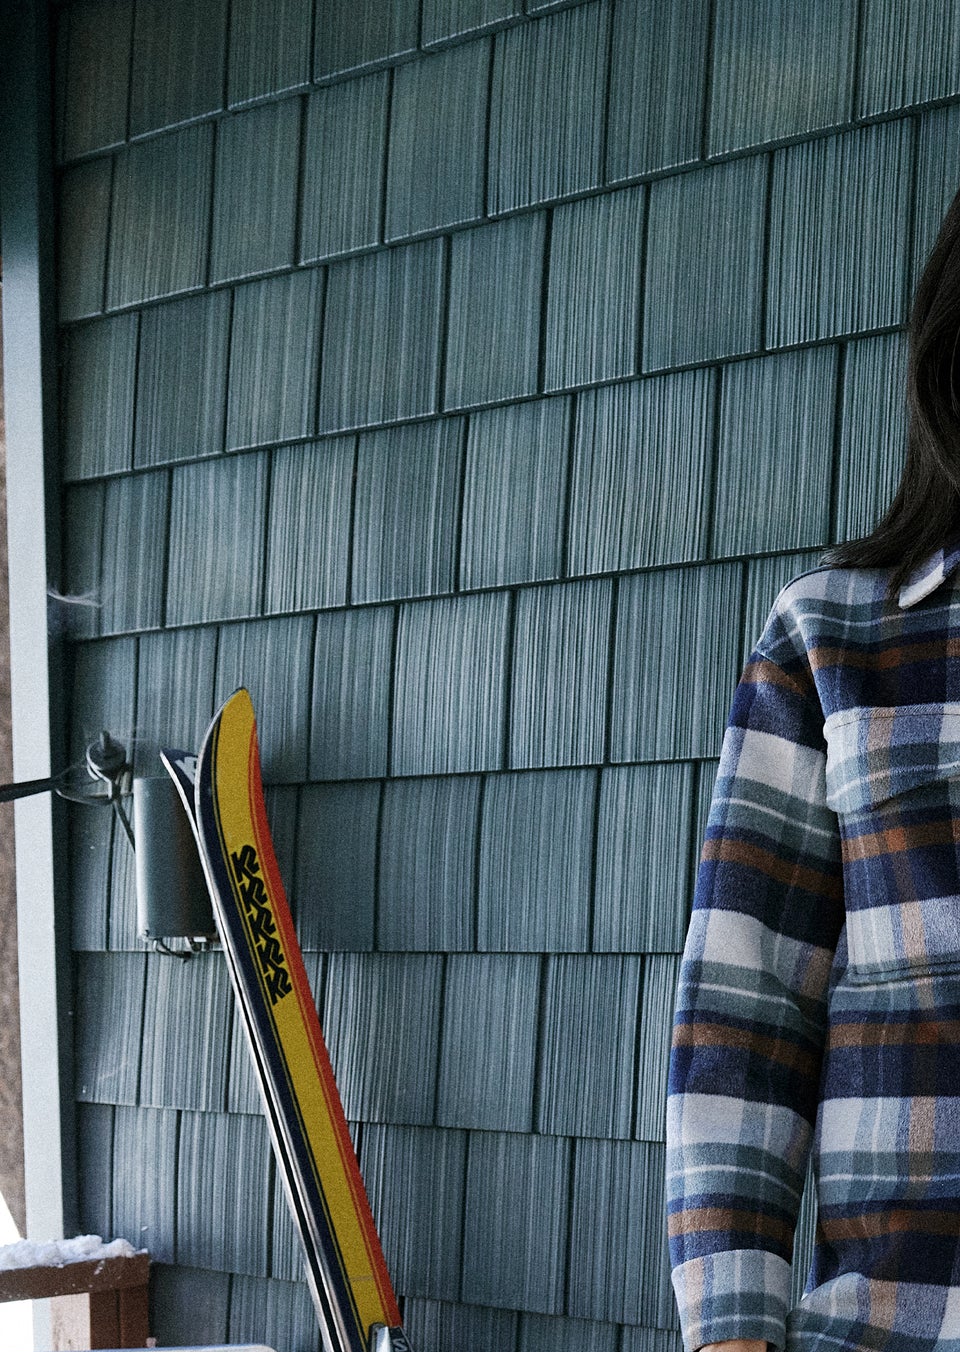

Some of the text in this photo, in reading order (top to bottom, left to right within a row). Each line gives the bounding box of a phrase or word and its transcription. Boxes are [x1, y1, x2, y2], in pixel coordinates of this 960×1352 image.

[230, 844, 260, 883] K2
[239, 876, 268, 915] K2
[248, 907, 276, 944] K2
[256, 937, 284, 974] K2
[264, 967, 292, 1006] K2
